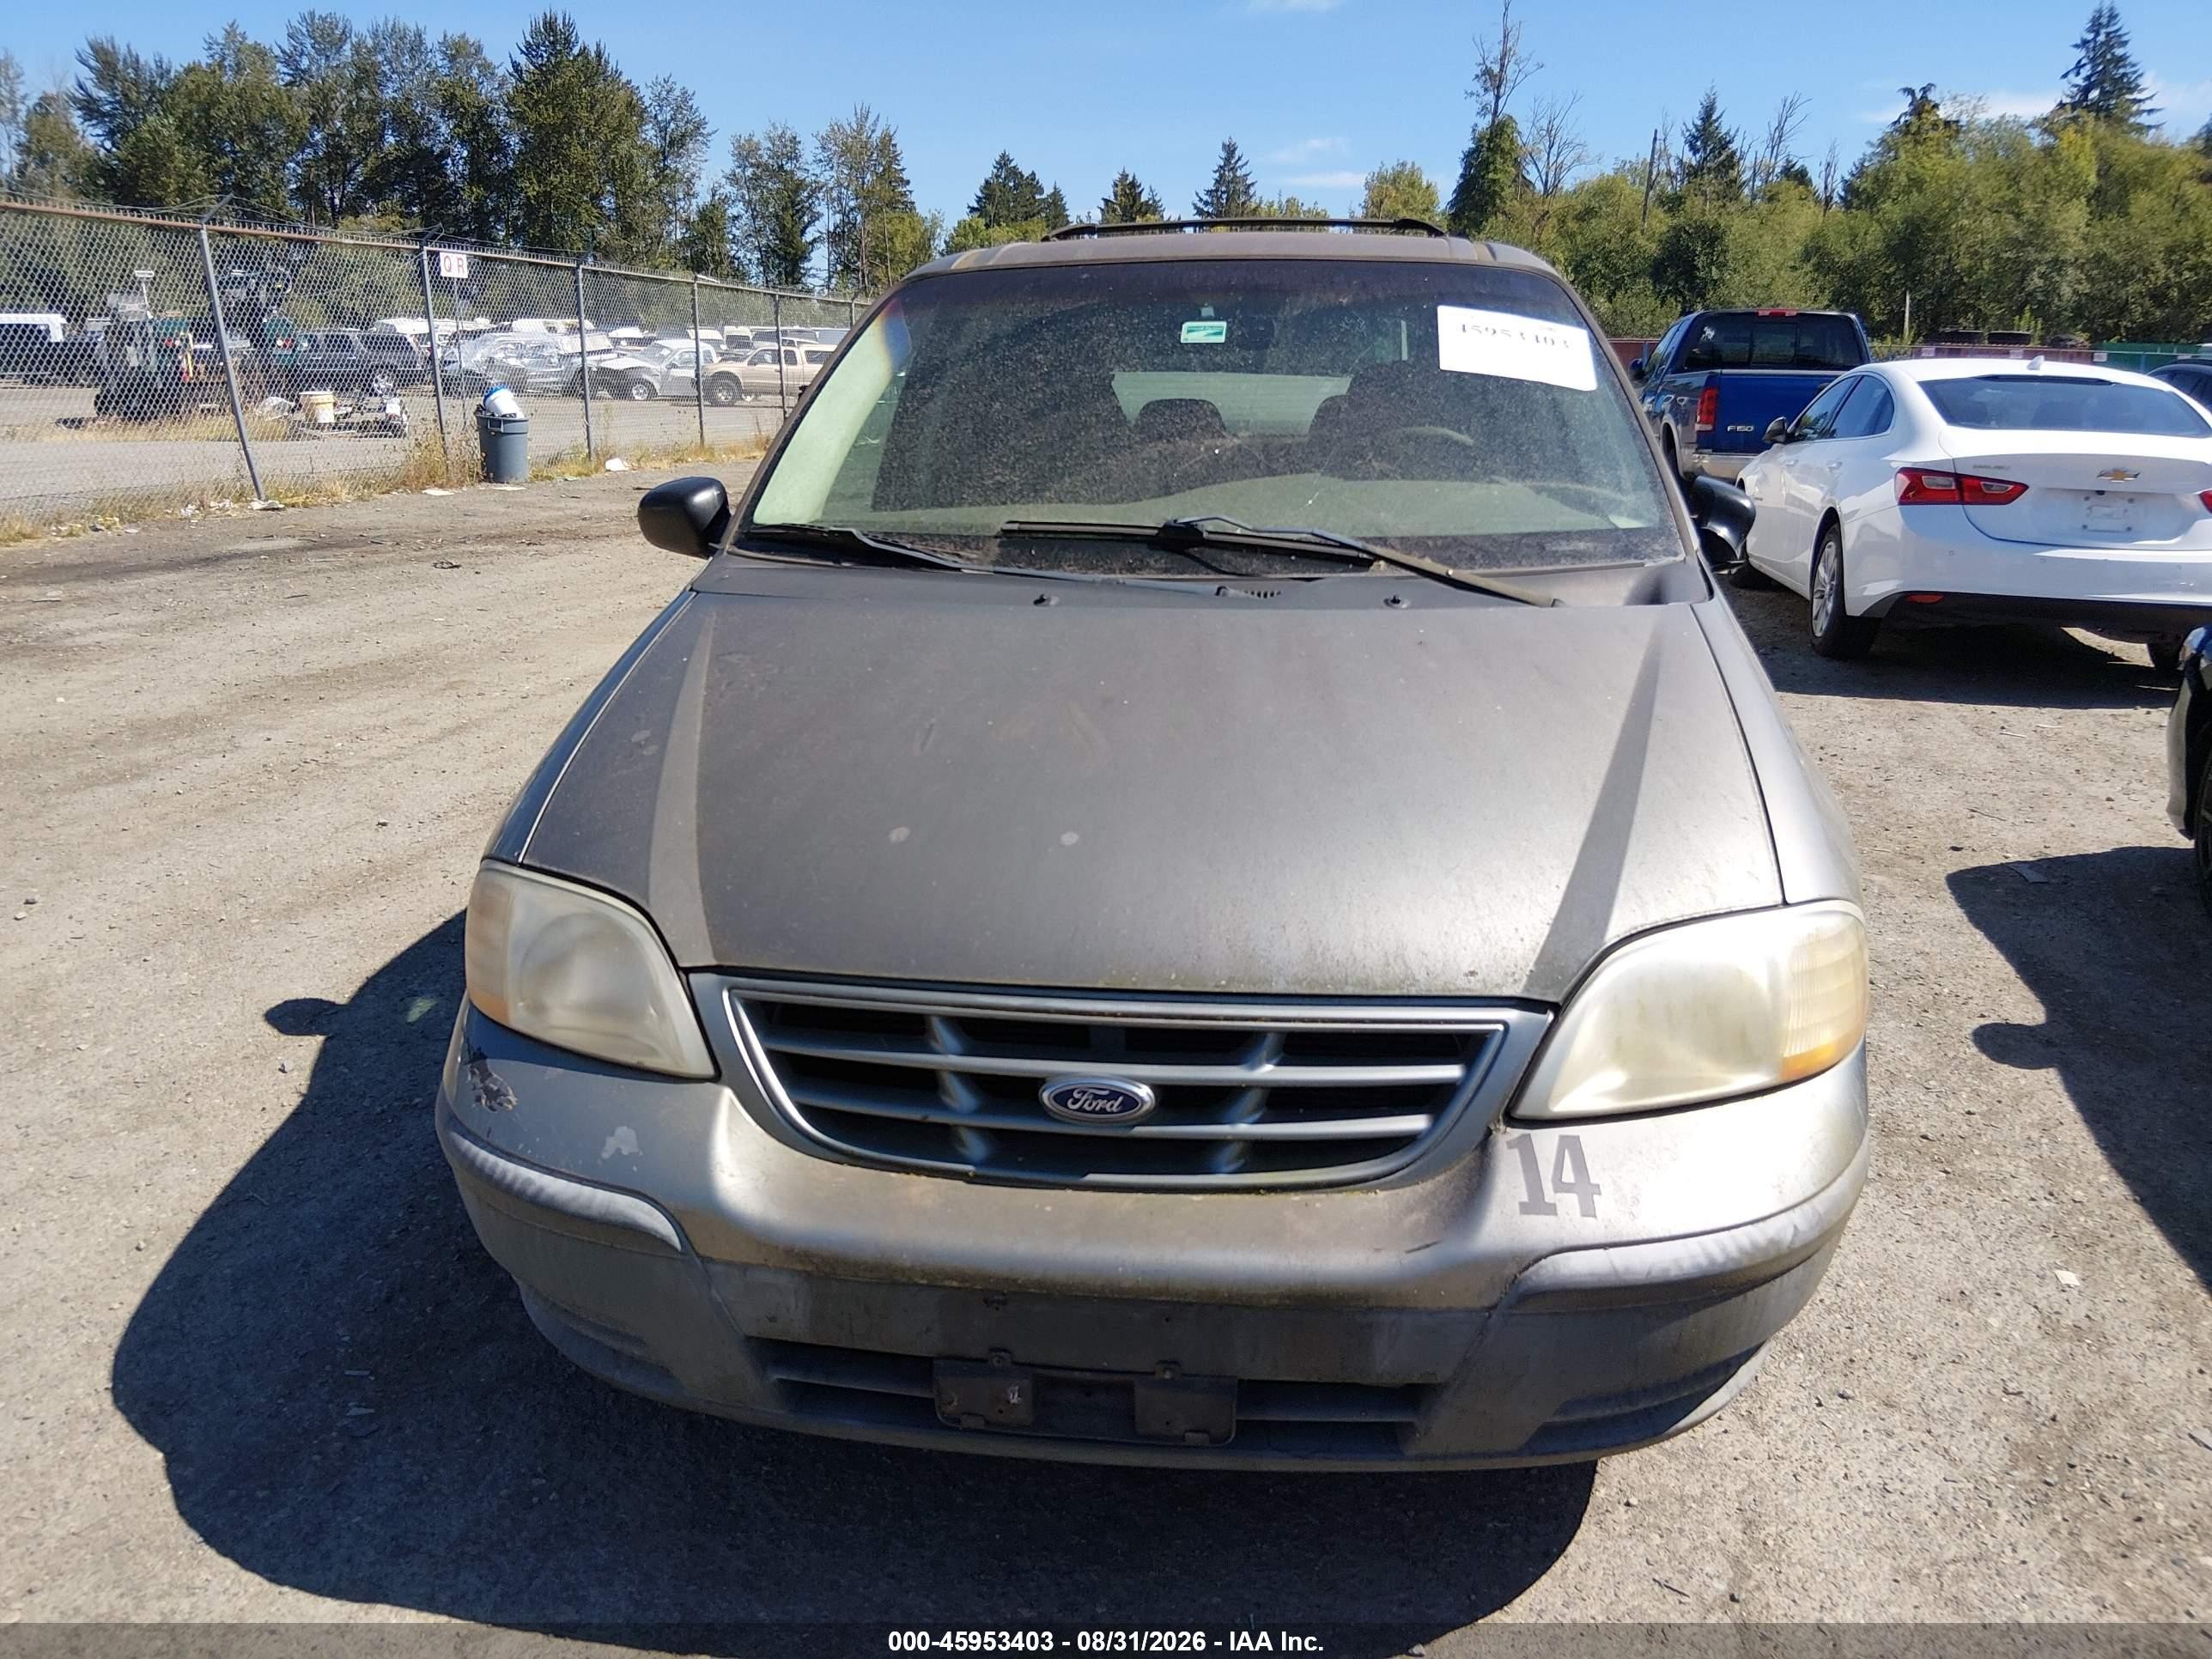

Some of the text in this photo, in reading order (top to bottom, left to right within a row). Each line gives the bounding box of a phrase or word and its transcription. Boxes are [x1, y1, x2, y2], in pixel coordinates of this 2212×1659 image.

[457, 258, 465, 274] R
[1066, 1087, 1124, 1113] Ford
[1506, 1133, 1601, 1218] 14
